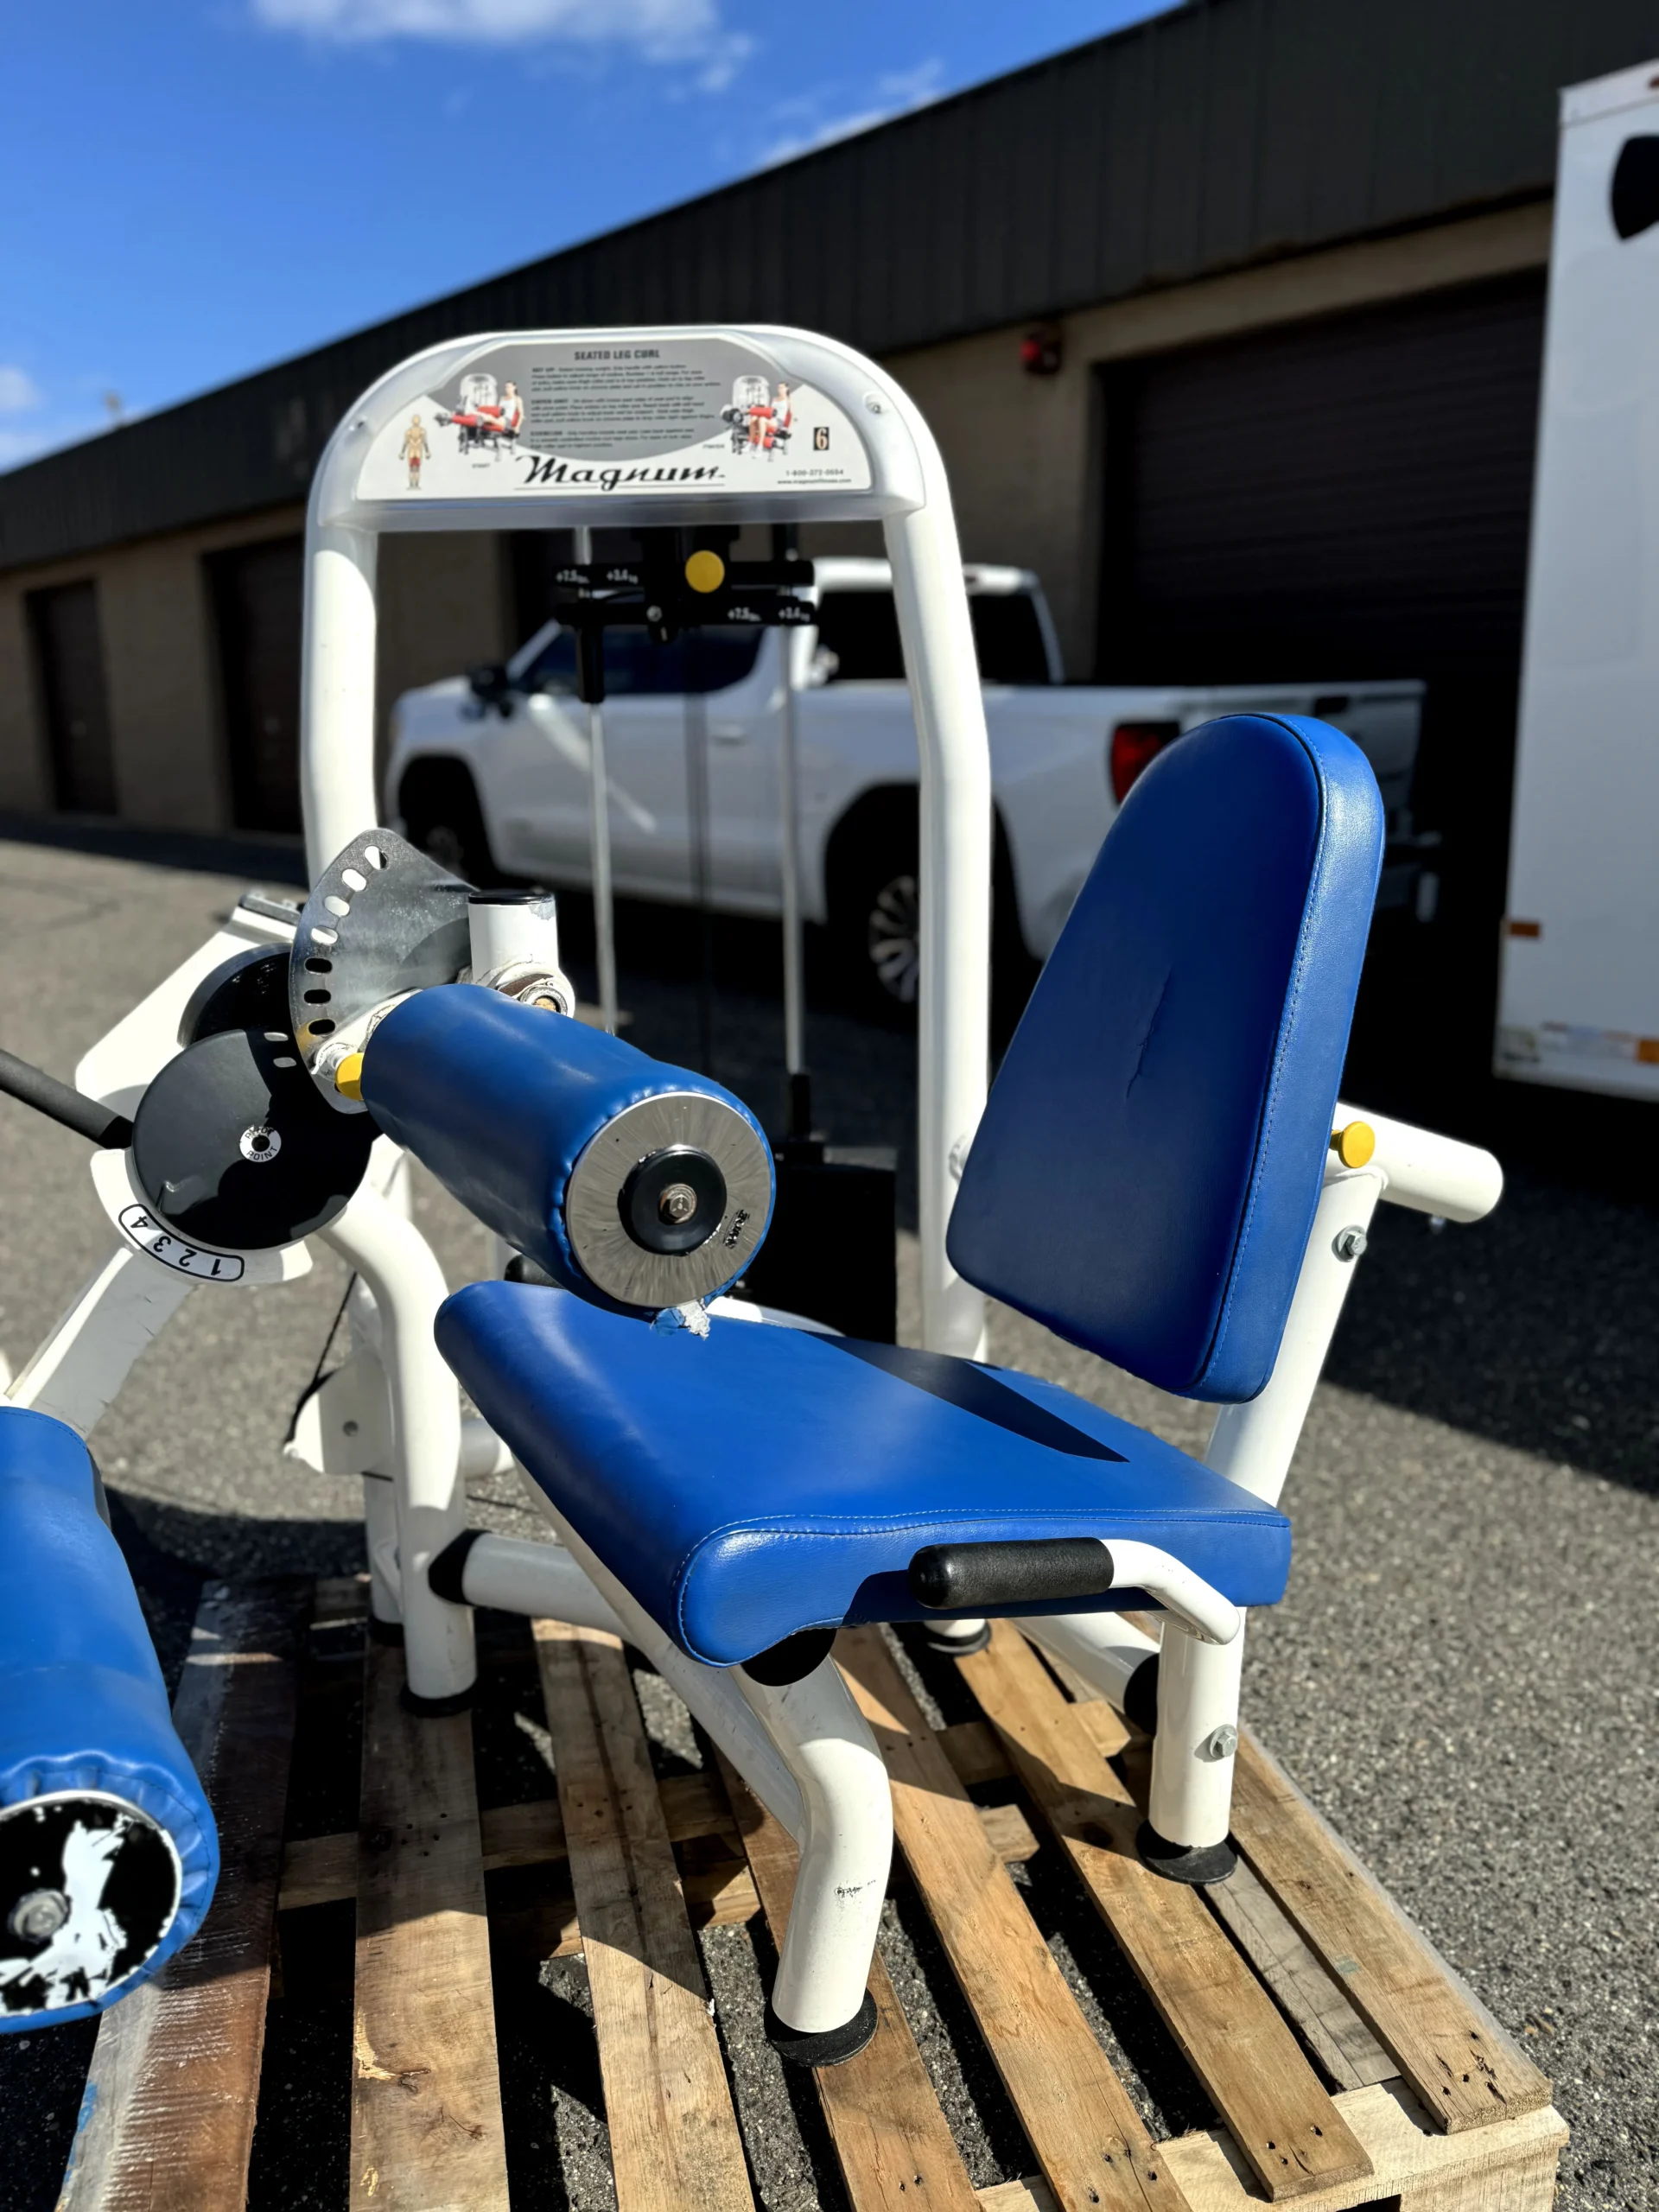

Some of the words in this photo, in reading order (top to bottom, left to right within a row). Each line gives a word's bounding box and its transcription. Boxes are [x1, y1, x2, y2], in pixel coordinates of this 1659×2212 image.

[575, 350, 610, 360] SEATED
[613, 349, 632, 359] LEG
[633, 349, 660, 359] CURL
[816, 427, 829, 450] 6
[246, 1146, 277, 1160] POINT
[130, 1216, 149, 1229] 4
[153, 1236, 172, 1253] 3
[178, 1248, 198, 1267] 2
[210, 1258, 221, 1276] 1
